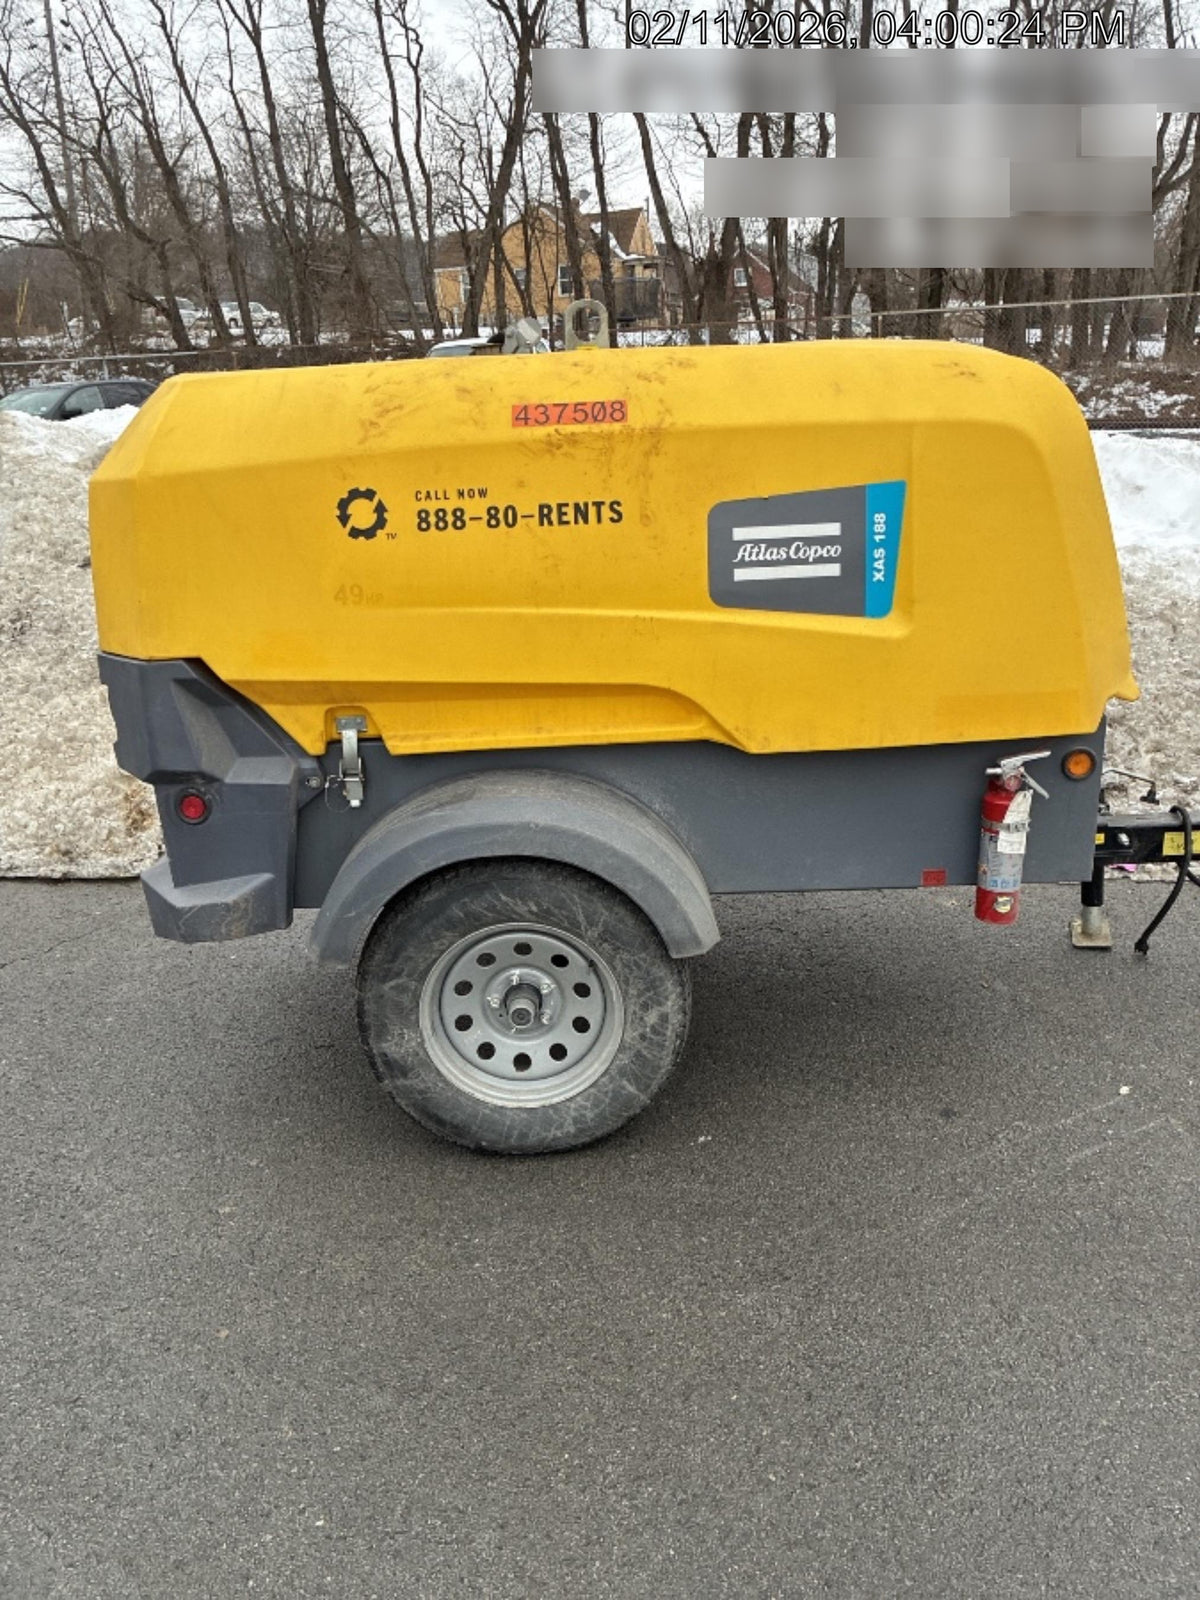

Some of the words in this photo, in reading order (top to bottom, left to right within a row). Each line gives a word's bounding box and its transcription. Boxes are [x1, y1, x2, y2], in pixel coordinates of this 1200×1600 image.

[514, 400, 627, 426] 437508
[415, 489, 450, 502] CALL
[457, 487, 489, 500] NOW
[416, 500, 624, 532] 888-80-RENTS
[873, 512, 887, 543] 188
[732, 543, 788, 563] Atlas
[788, 541, 842, 562] Copco
[872, 547, 886, 582] XAS
